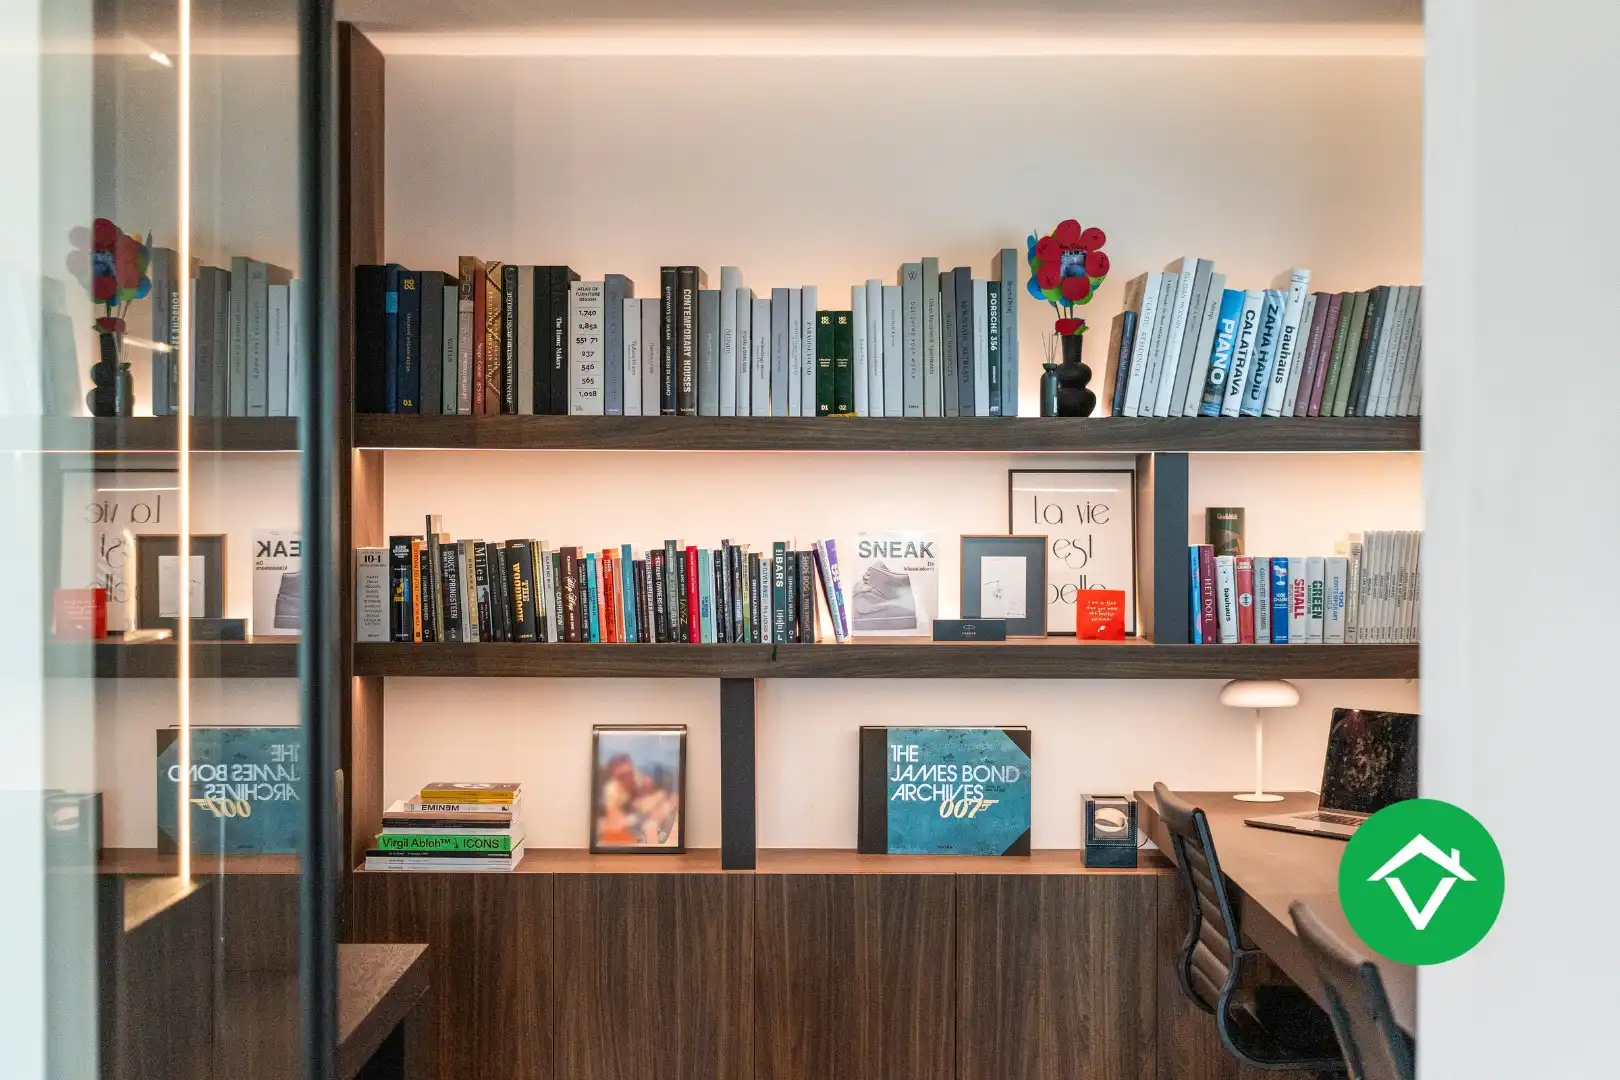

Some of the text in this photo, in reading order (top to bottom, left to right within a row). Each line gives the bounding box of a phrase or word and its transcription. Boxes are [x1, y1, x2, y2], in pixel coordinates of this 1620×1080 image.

[960, 300, 968, 342] MOUNTAIN
[989, 292, 997, 334] PORSCHE
[683, 288, 692, 393] CONTEMPORARY HOUSES
[1134, 332, 1147, 377] RESIDENCES
[1210, 318, 1236, 385] PIANO
[1230, 309, 1256, 396] CALATRAVA
[1250, 304, 1279, 400] ZAHA HADID
[1275, 325, 1296, 384] bauhaus
[581, 364, 595, 372] 546
[581, 376, 595, 384] 565
[1034, 495, 1110, 525] La vie
[475, 547, 485, 581] Miles
[802, 556, 810, 574] SHOE
[859, 540, 934, 559] SNEAK
[1053, 534, 1093, 569] est
[776, 557, 784, 588] BARS
[448, 574, 458, 619] SPRINGSTEEN
[512, 562, 524, 622] WOODBOOK
[521, 580, 530, 602] THE
[1204, 578, 1213, 623] HET DOEL
[1294, 578, 1305, 619] SMALL
[1312, 580, 1323, 619] GREEN
[556, 592, 564, 625] CASHFLOW
[1259, 599, 1267, 630] BUILDINGS
[891, 745, 919, 762] THE
[890, 765, 1020, 783] JAMES BOND
[891, 784, 984, 801] ARCHIVES
[939, 799, 987, 819] 007
[382, 838, 408, 850] Virgil
[463, 838, 500, 849] ICONS
